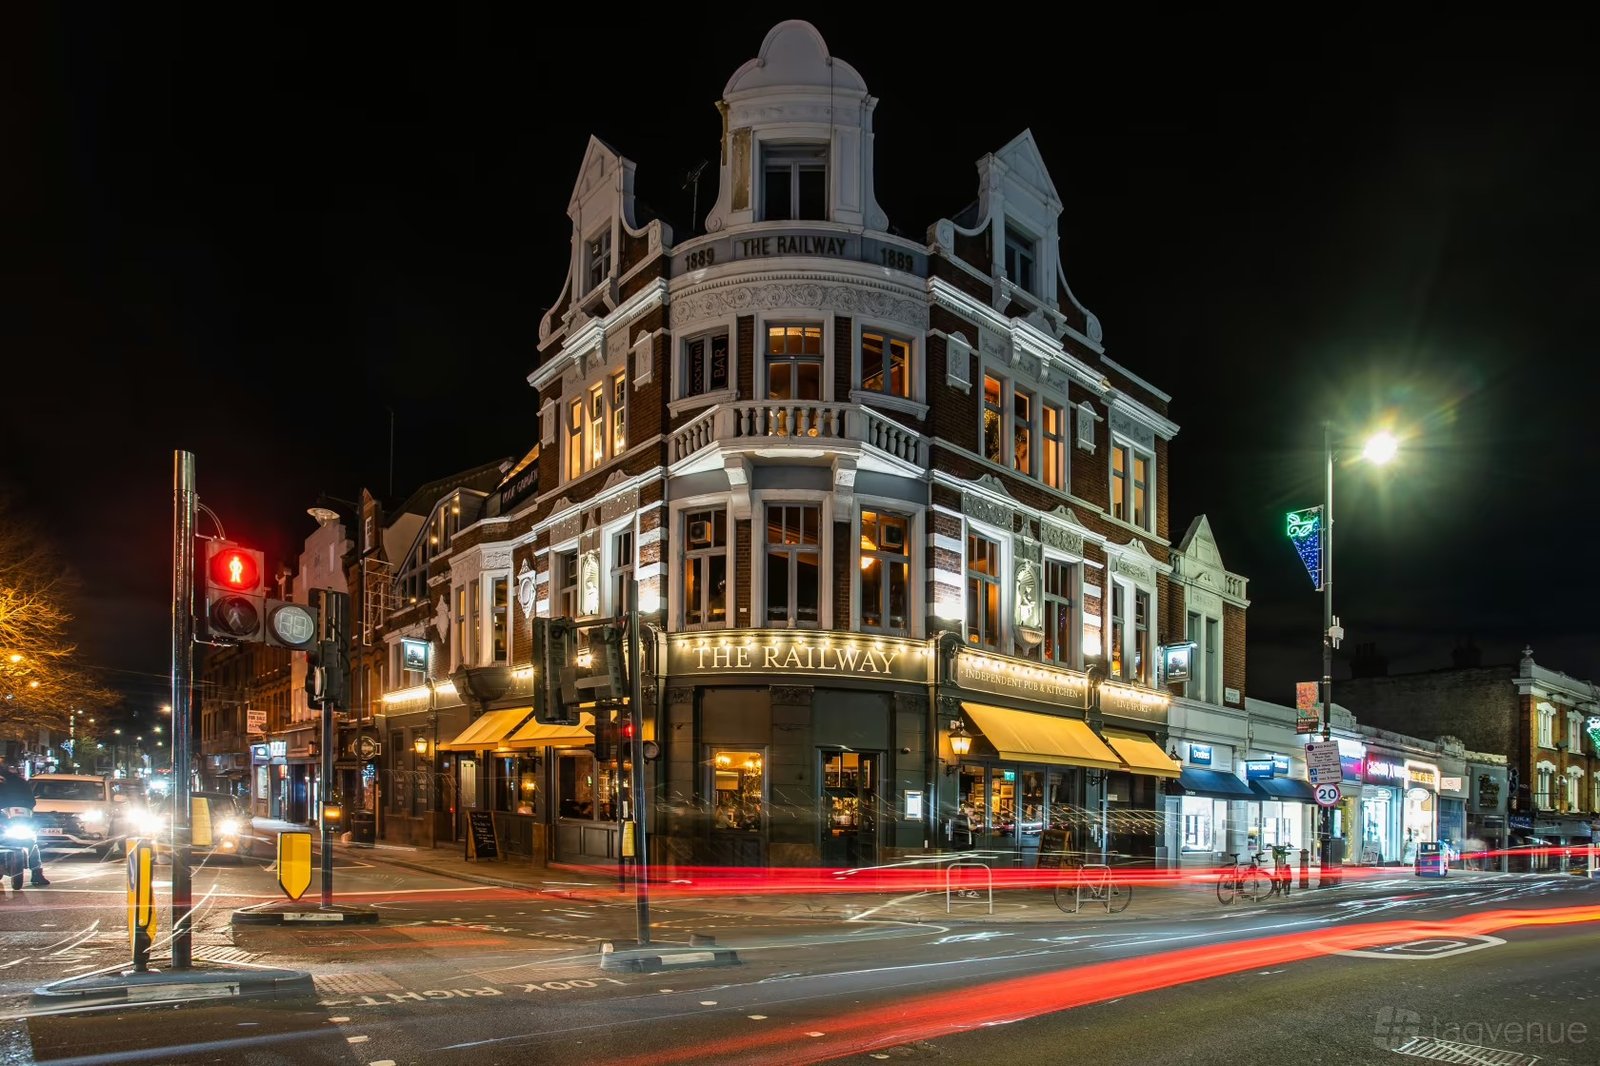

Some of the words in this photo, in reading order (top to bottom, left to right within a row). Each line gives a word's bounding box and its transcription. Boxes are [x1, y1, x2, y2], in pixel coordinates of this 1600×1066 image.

[741, 236, 770, 257] THE
[776, 235, 847, 256] RAILWAY
[684, 247, 716, 272] 1889
[880, 247, 914, 273] 1889
[713, 347, 727, 378] BAR
[693, 645, 752, 669] THE
[761, 645, 899, 675] RAILWAY
[965, 668, 1024, 688] INDEPENDENT
[1024, 680, 1039, 692] PUB
[1039, 684, 1046, 693] &
[1046, 684, 1078, 699] KITCHEN
[1318, 788, 1337, 800] 20
[350, 985, 504, 1006] RIGHT
[514, 977, 630, 993] LOOK
